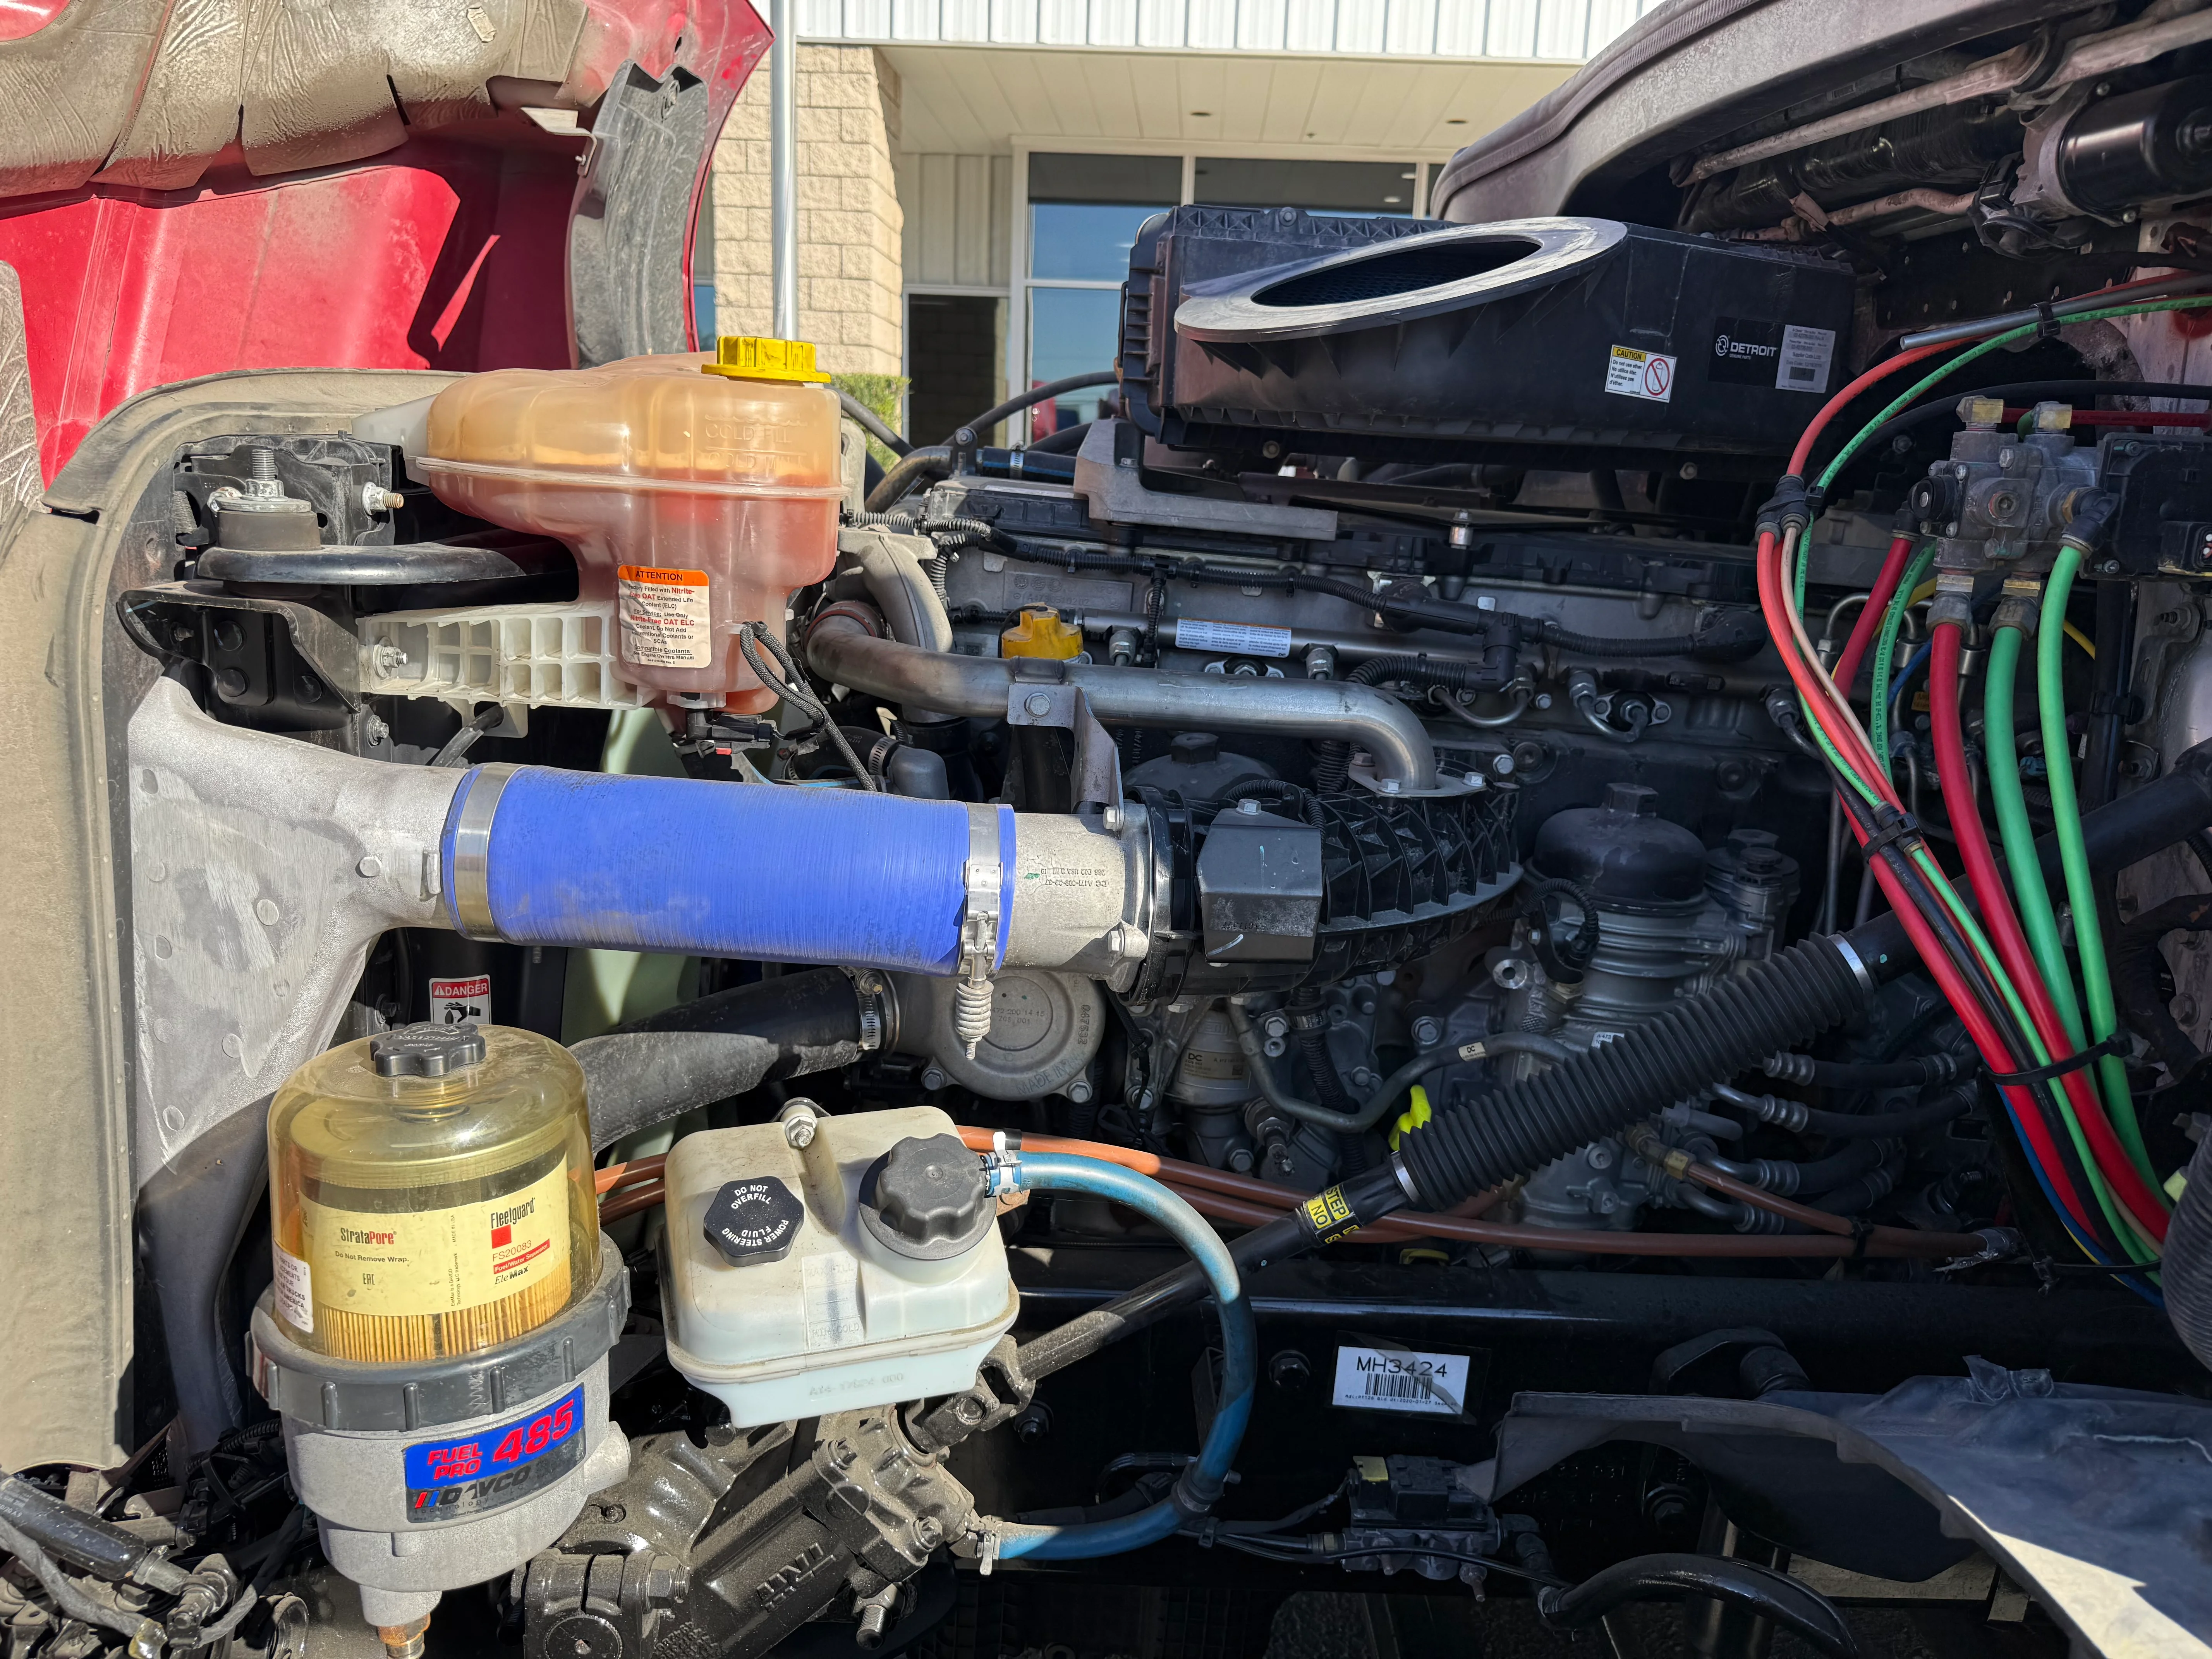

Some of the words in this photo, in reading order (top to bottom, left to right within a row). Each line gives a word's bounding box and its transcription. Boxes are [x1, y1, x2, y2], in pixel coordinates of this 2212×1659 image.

[1617, 349, 1642, 360] CAUTION
[1730, 342, 1776, 357] DETROIT
[706, 423, 754, 440] COLD
[636, 571, 683, 581] ATTENTION
[630, 615, 661, 624] Nitrite-Free
[445, 983, 487, 996] DANGER
[1078, 1004, 1091, 1045] 047532
[1188, 1053, 1202, 1061] DC
[1016, 1070, 1051, 1095] MADE
[734, 1187, 747, 1196] DO
[750, 1185, 768, 1193] NOT
[731, 1193, 771, 1209] OVERFILL
[1326, 1187, 1346, 1215] STEP
[490, 1197, 534, 1229] Fleetguard
[1311, 1204, 1328, 1225] NO
[722, 1228, 763, 1246] STEERING
[741, 1226, 771, 1238] FLUID
[764, 1219, 789, 1243] POWER
[493, 1240, 532, 1260] FS20083
[494, 1255, 524, 1273] Fuel/Water
[526, 1243, 548, 1262] Separator
[358, 1254, 386, 1263] Remove
[387, 1255, 409, 1264] Wrap.
[291, 1264, 298, 1272] OR
[284, 1292, 304, 1308] AMERICA
[287, 1285, 305, 1300] TRUCKS
[1356, 1356, 1447, 1377] MH3424
[492, 1399, 574, 1463] 485
[428, 1443, 483, 1465] FUEL
[433, 1459, 481, 1480] PRO
[440, 1467, 531, 1506] DAVCO
